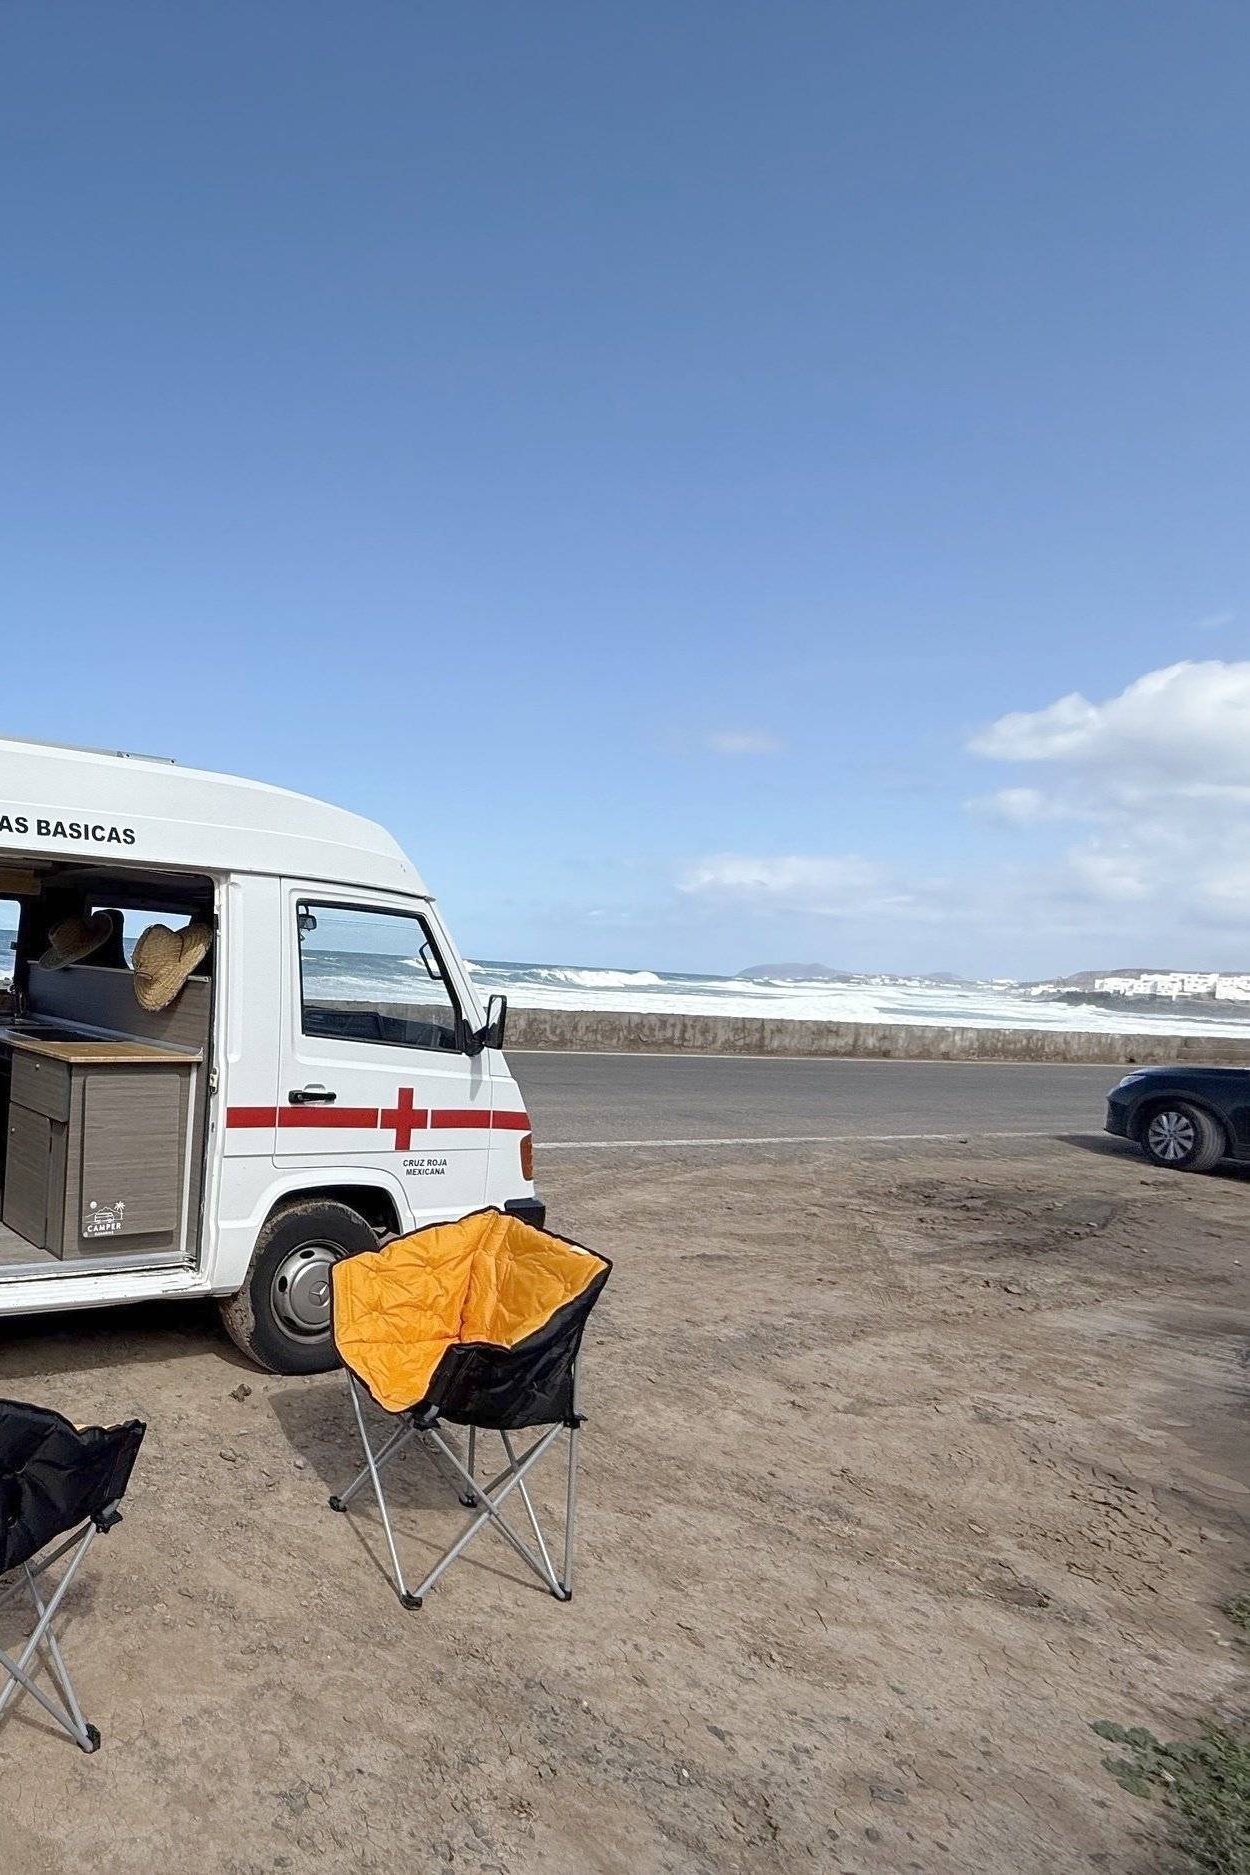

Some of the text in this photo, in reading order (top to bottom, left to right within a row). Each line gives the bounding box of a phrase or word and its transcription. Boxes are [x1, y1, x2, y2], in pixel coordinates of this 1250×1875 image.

[36, 819, 137, 845] BASICAS
[403, 1159, 447, 1167] CRUZ ROJA
[405, 1168, 446, 1176] MEXICANA
[87, 1223, 121, 1232] CAMPER
